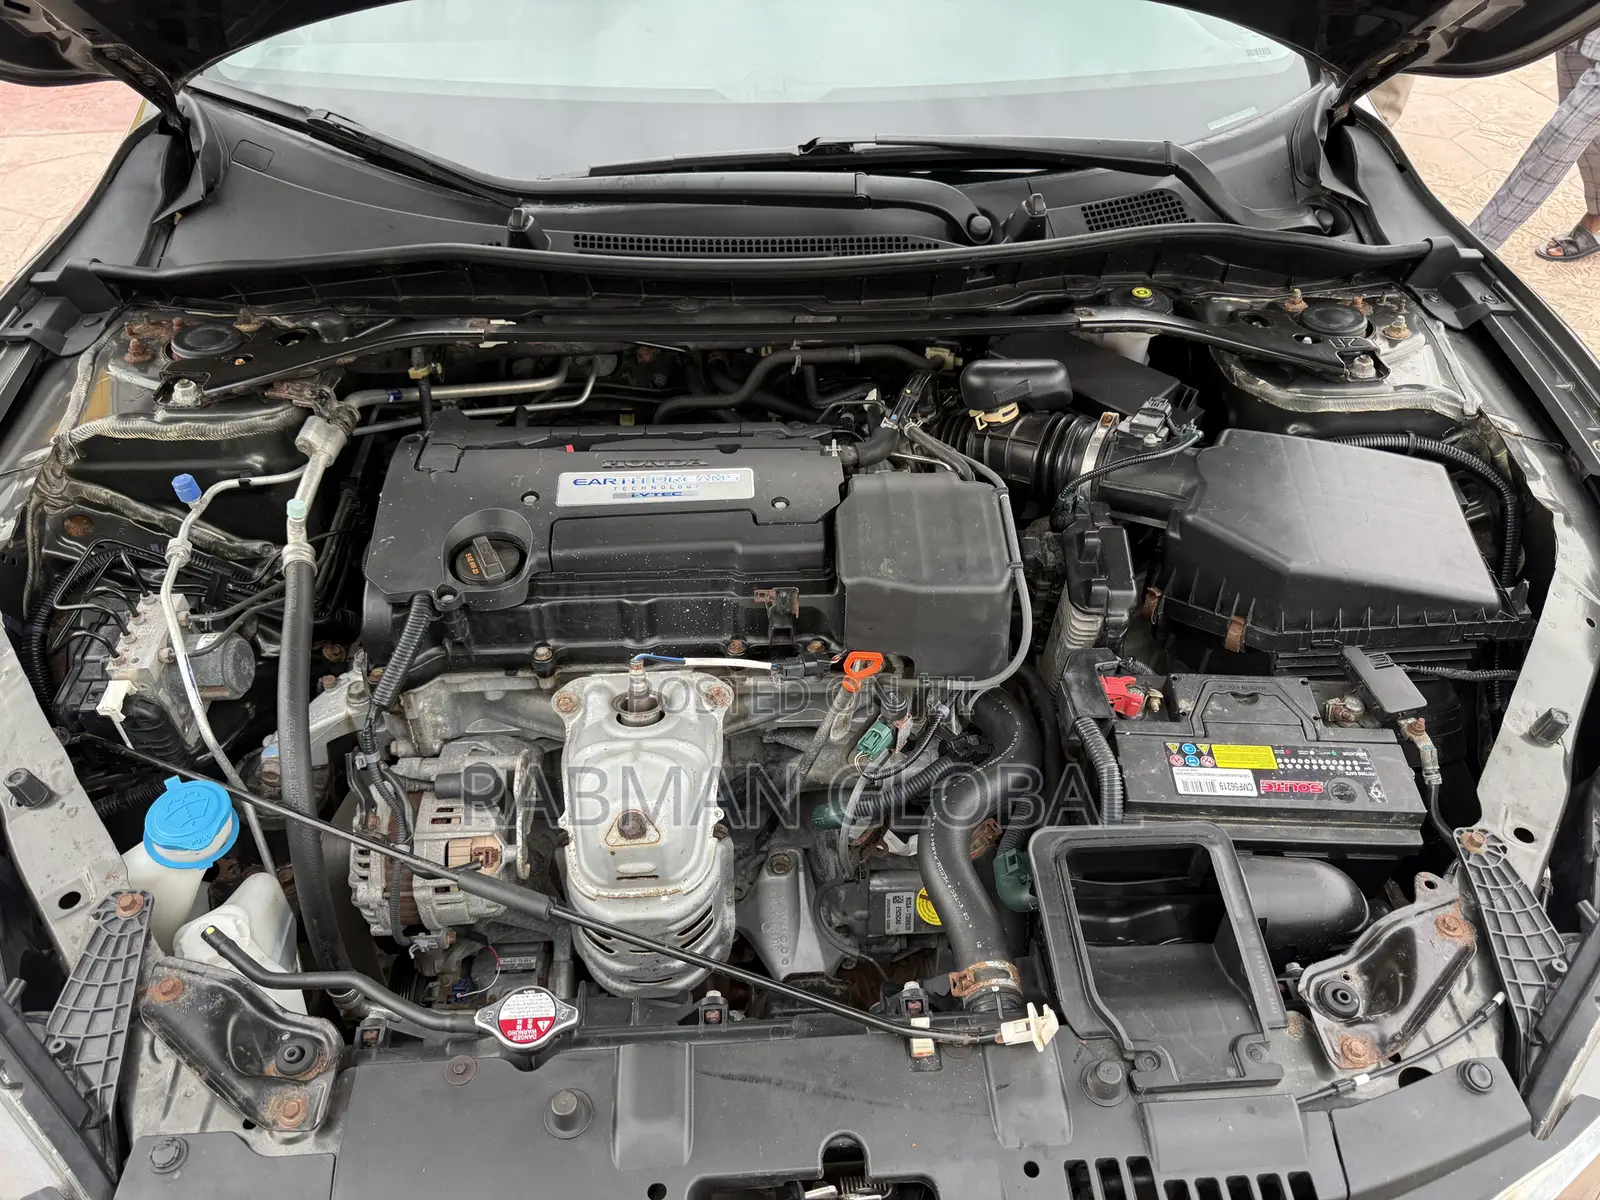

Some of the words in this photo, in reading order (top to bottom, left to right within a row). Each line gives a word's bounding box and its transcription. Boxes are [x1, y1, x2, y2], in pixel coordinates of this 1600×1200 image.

[602, 459, 709, 469] HONDA
[573, 474, 646, 486] EARTH
[651, 473, 740, 484] DREAMS
[1219, 781, 1254, 792] CMF56219
[1261, 781, 1324, 794] SOLITE
